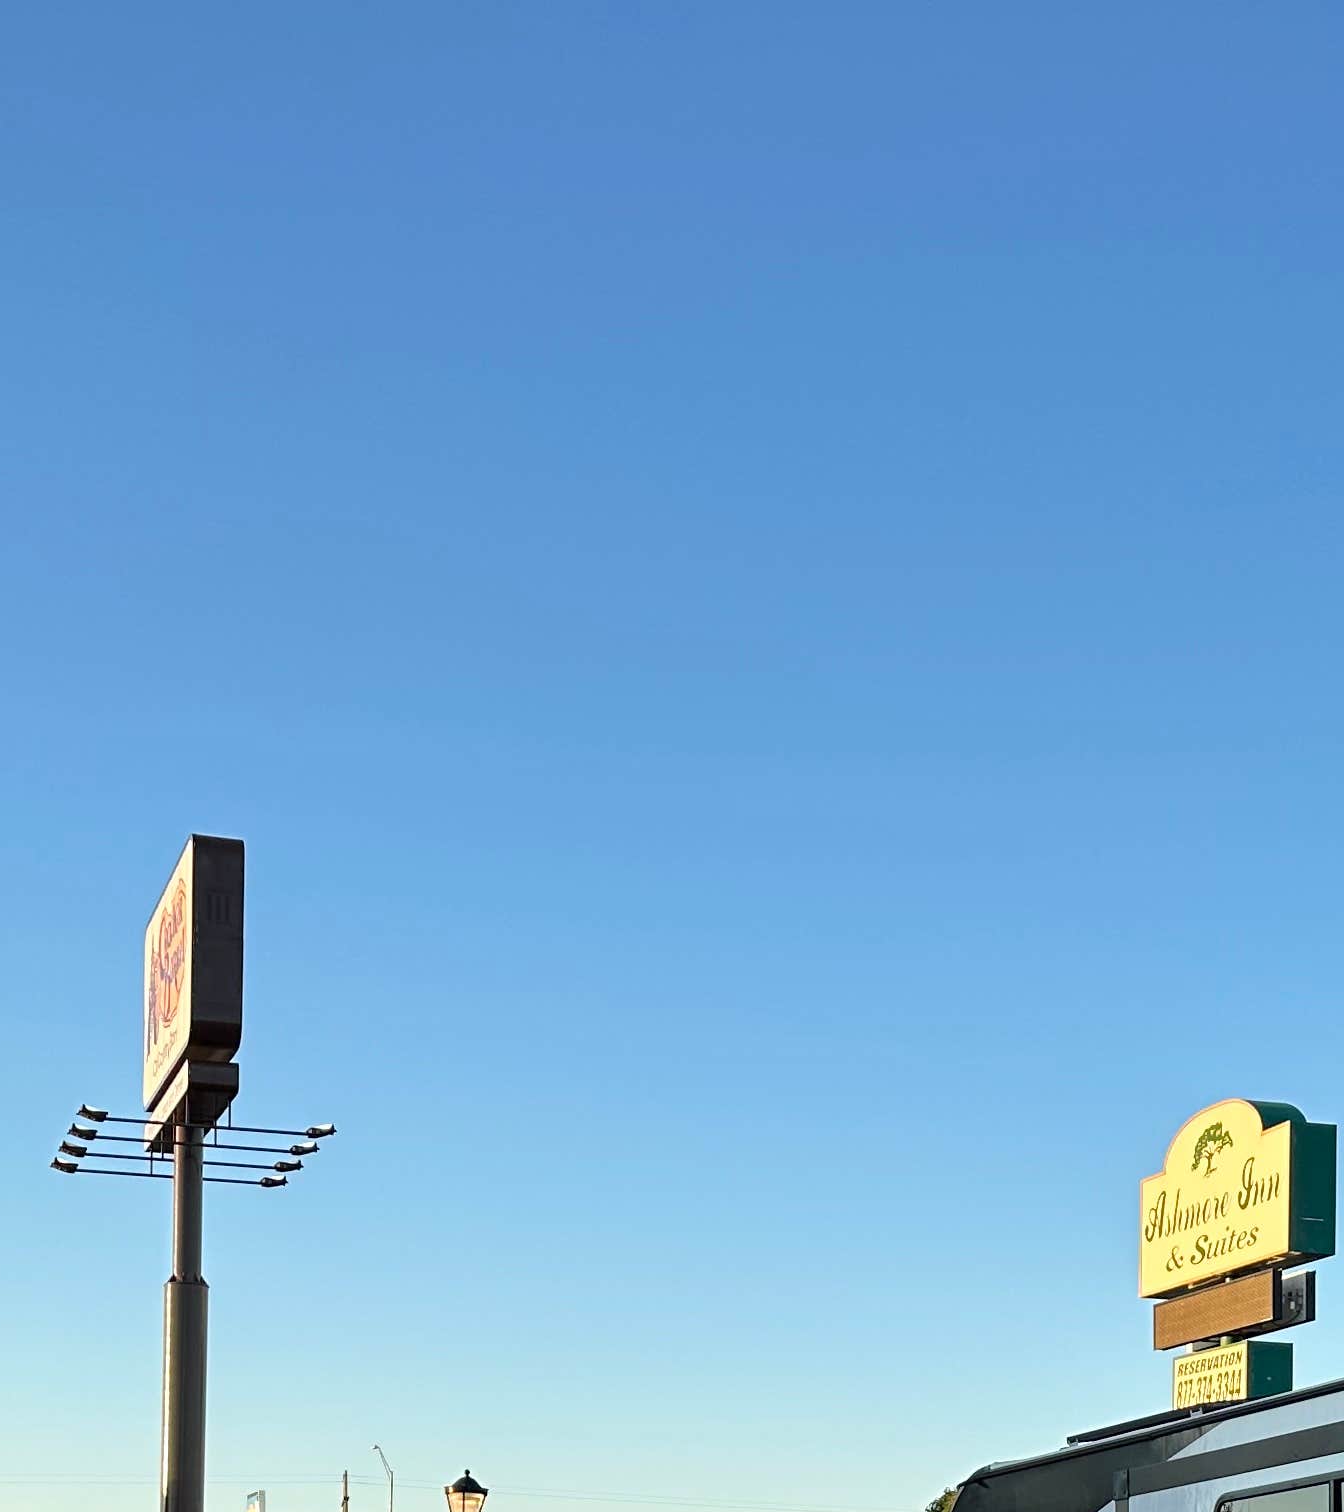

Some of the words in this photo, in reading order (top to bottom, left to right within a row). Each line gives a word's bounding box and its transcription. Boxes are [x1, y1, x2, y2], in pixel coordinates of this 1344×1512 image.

[1145, 1188, 1230, 1243] Ashmore
[1237, 1156, 1280, 1210] Inn
[1166, 1245, 1184, 1272] &
[1190, 1225, 1260, 1265] Suites
[1178, 1350, 1243, 1377] RESERVATION
[1177, 1369, 1242, 1410] 877-374-3344
